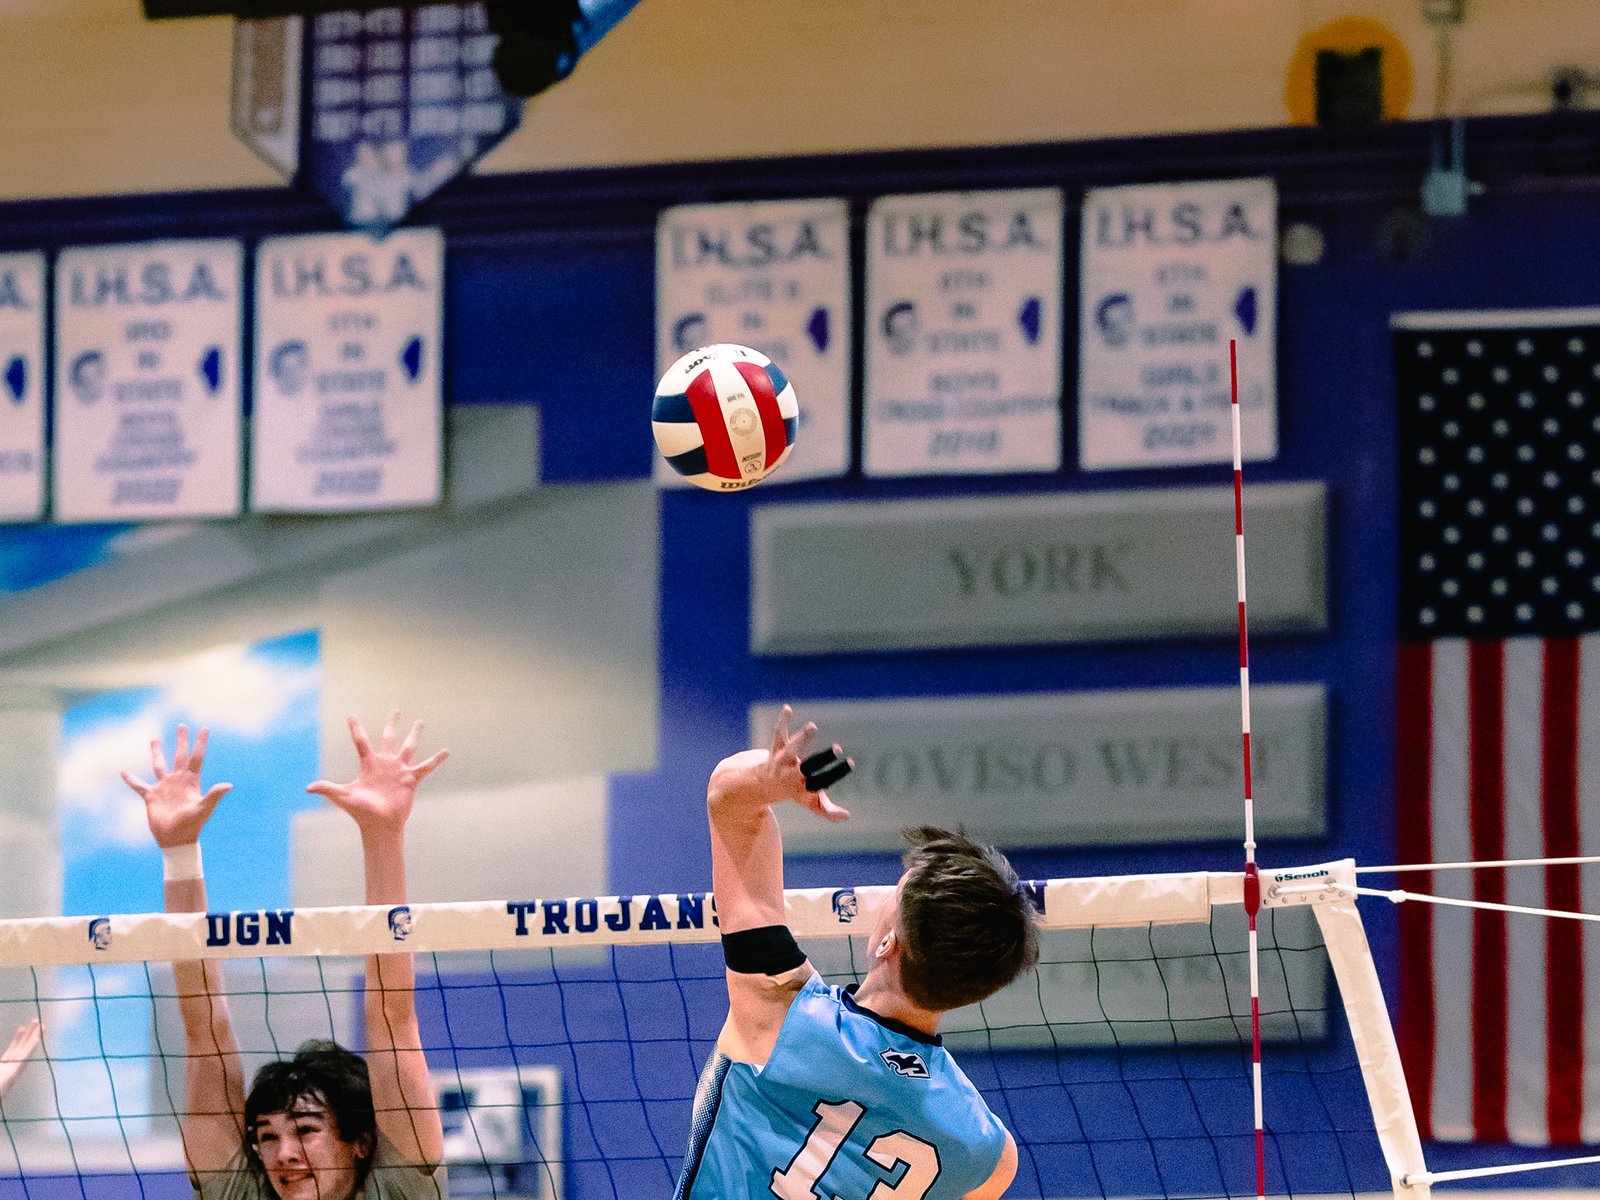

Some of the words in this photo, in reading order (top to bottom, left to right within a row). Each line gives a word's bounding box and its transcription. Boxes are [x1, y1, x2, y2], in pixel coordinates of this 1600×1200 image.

[947, 540, 1134, 599] YORK
[1098, 734, 1284, 790] WEST
[206, 911, 294, 947] DGN
